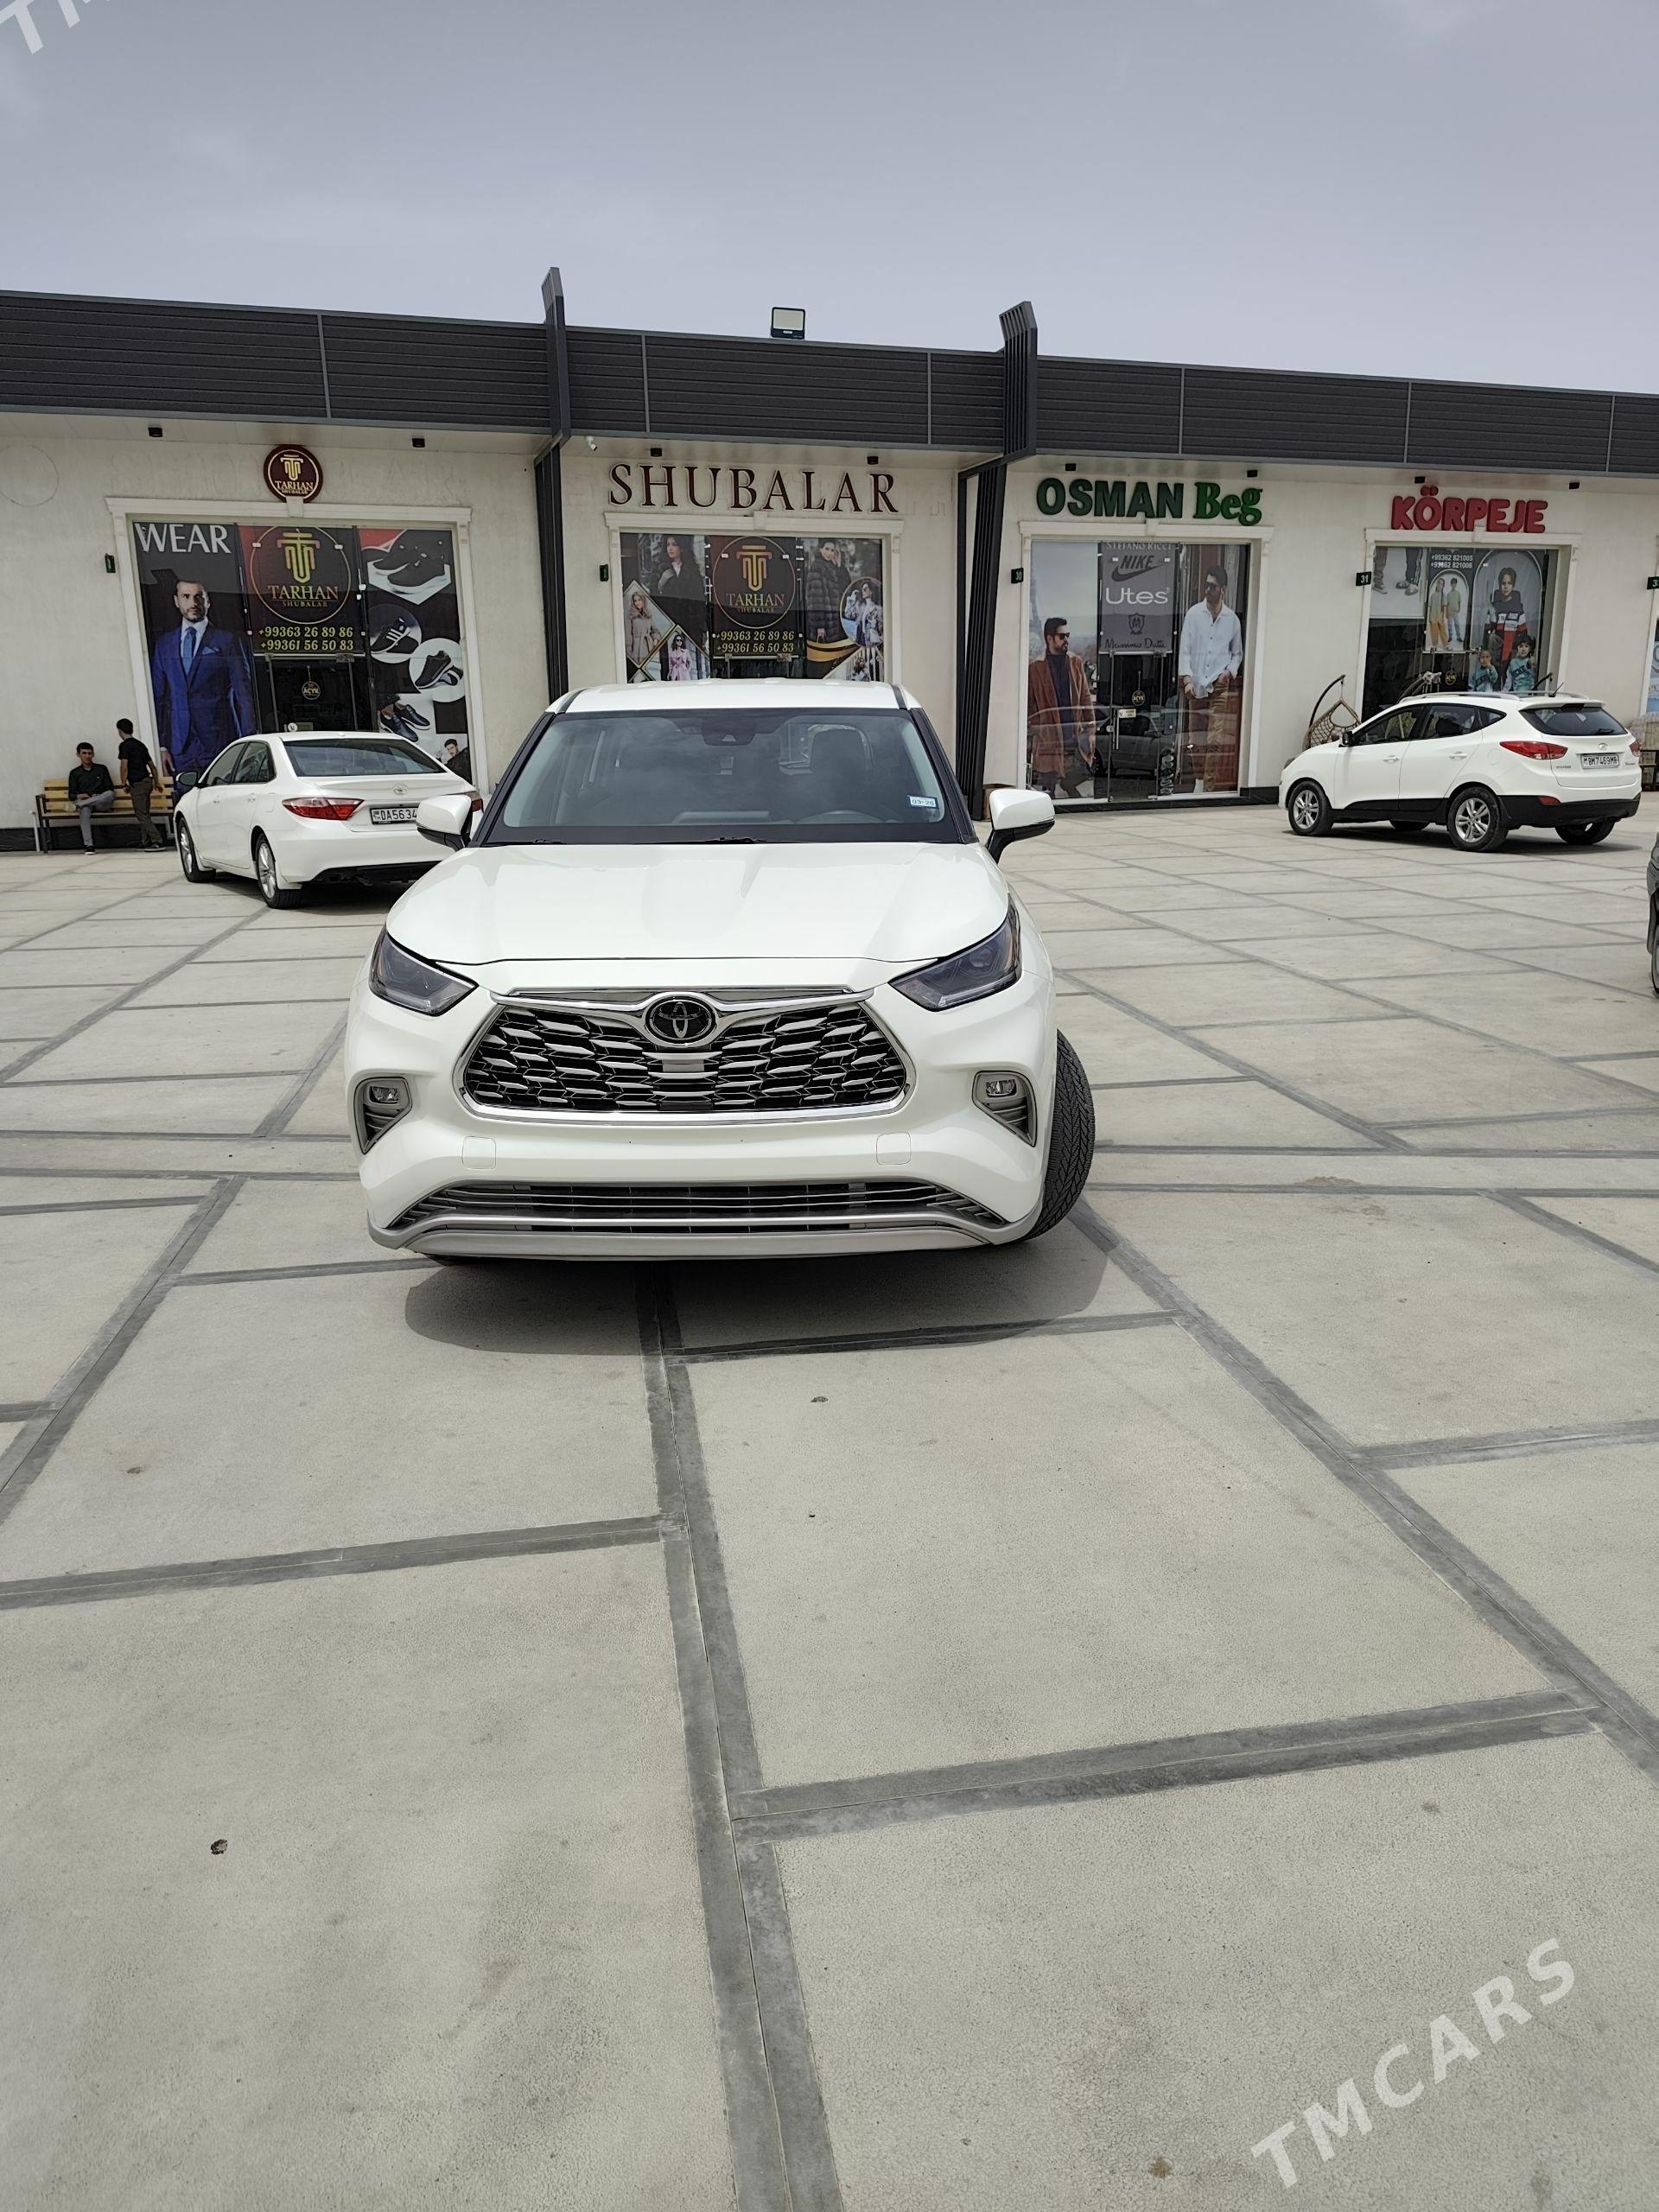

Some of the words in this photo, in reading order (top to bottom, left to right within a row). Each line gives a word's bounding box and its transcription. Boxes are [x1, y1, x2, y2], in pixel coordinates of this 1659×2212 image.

[274, 480, 314, 491] TARHAN
[609, 463, 899, 513] SHUBALAR
[1036, 477, 1184, 518] OSMAN
[1192, 481, 1263, 526] Beg
[1391, 486, 1548, 533] KÖRPEJE
[134, 522, 232, 554] WEAR
[1120, 555, 1155, 569] NIKE
[1360, 575, 1369, 583] 31
[268, 585, 339, 601] TARHAN
[726, 593, 785, 607] TARHAN
[1106, 588, 1168, 605] Utes
[259, 626, 301, 638] +99363
[304, 626, 319, 638] 26
[321, 626, 336, 638] 89
[339, 626, 353, 638] 86
[716, 631, 751, 641] +99363
[753, 631, 766, 641] 26
[768, 631, 780, 641] 89
[782, 631, 795, 641] 86
[261, 639, 300, 651] +99361
[304, 639, 319, 651] 56
[321, 639, 336, 651] 50
[340, 639, 354, 651] 83
[717, 643, 749, 653] +99361
[753, 643, 765, 653] 56
[767, 643, 780, 653] 50
[782, 643, 794, 653] 83
